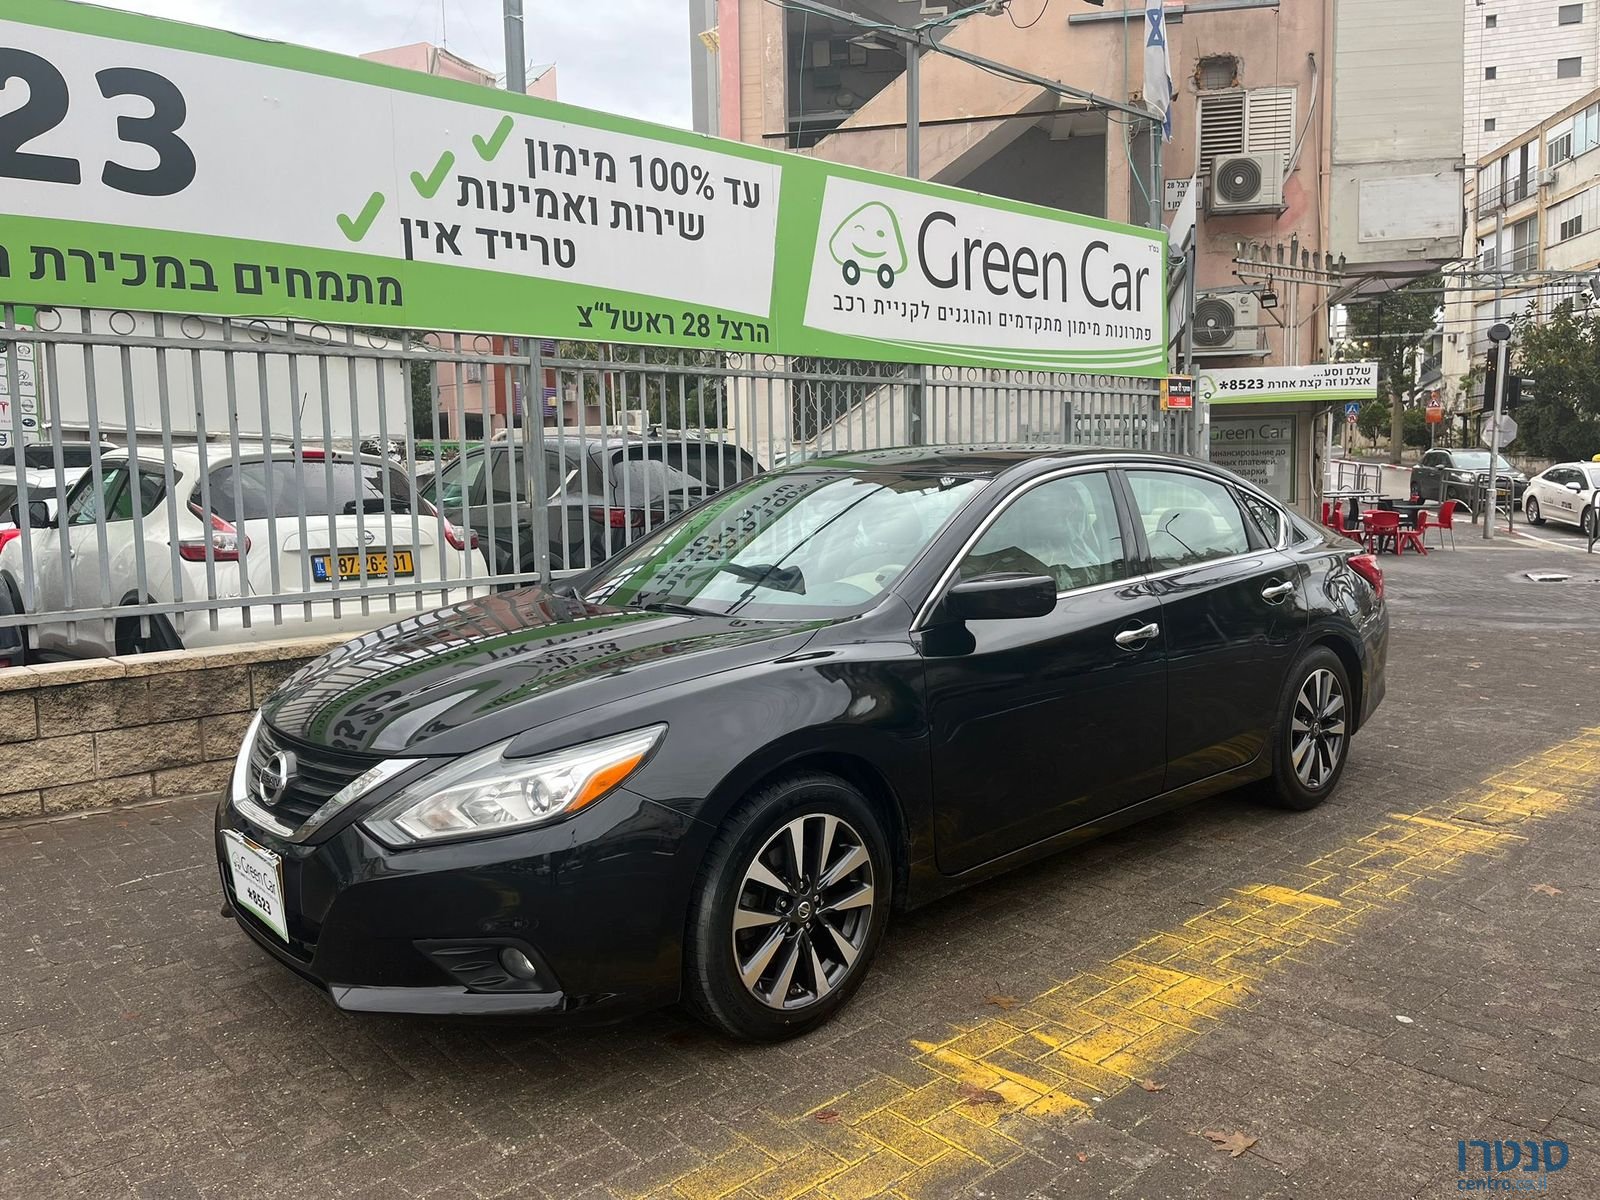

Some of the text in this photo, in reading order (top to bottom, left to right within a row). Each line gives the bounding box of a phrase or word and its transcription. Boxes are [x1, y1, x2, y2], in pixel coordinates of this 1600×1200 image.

[0, 47, 197, 197] 23
[524, 137, 761, 209] עד 100% מימון
[456, 174, 705, 241] שירות ואמינות
[400, 217, 577, 269] טרייד אין
[29, 245, 219, 293] במכירת
[916, 210, 1150, 312] Green Car
[233, 261, 404, 307] מתמחים
[681, 311, 711, 338] 28
[716, 313, 770, 344] הרצל
[833, 294, 1151, 341] פתרונות מימון מתקדמים והוגנים לקניית רכב
[1267, 379, 1296, 389] אחרת
[1299, 379, 1322, 390] קצת
[1325, 378, 1337, 387] זה
[1340, 376, 1371, 386] אצלנו
[1346, 366, 1371, 376] שלם
[1258, 424, 1287, 439] Car
[1275, 448, 1286, 457] до
